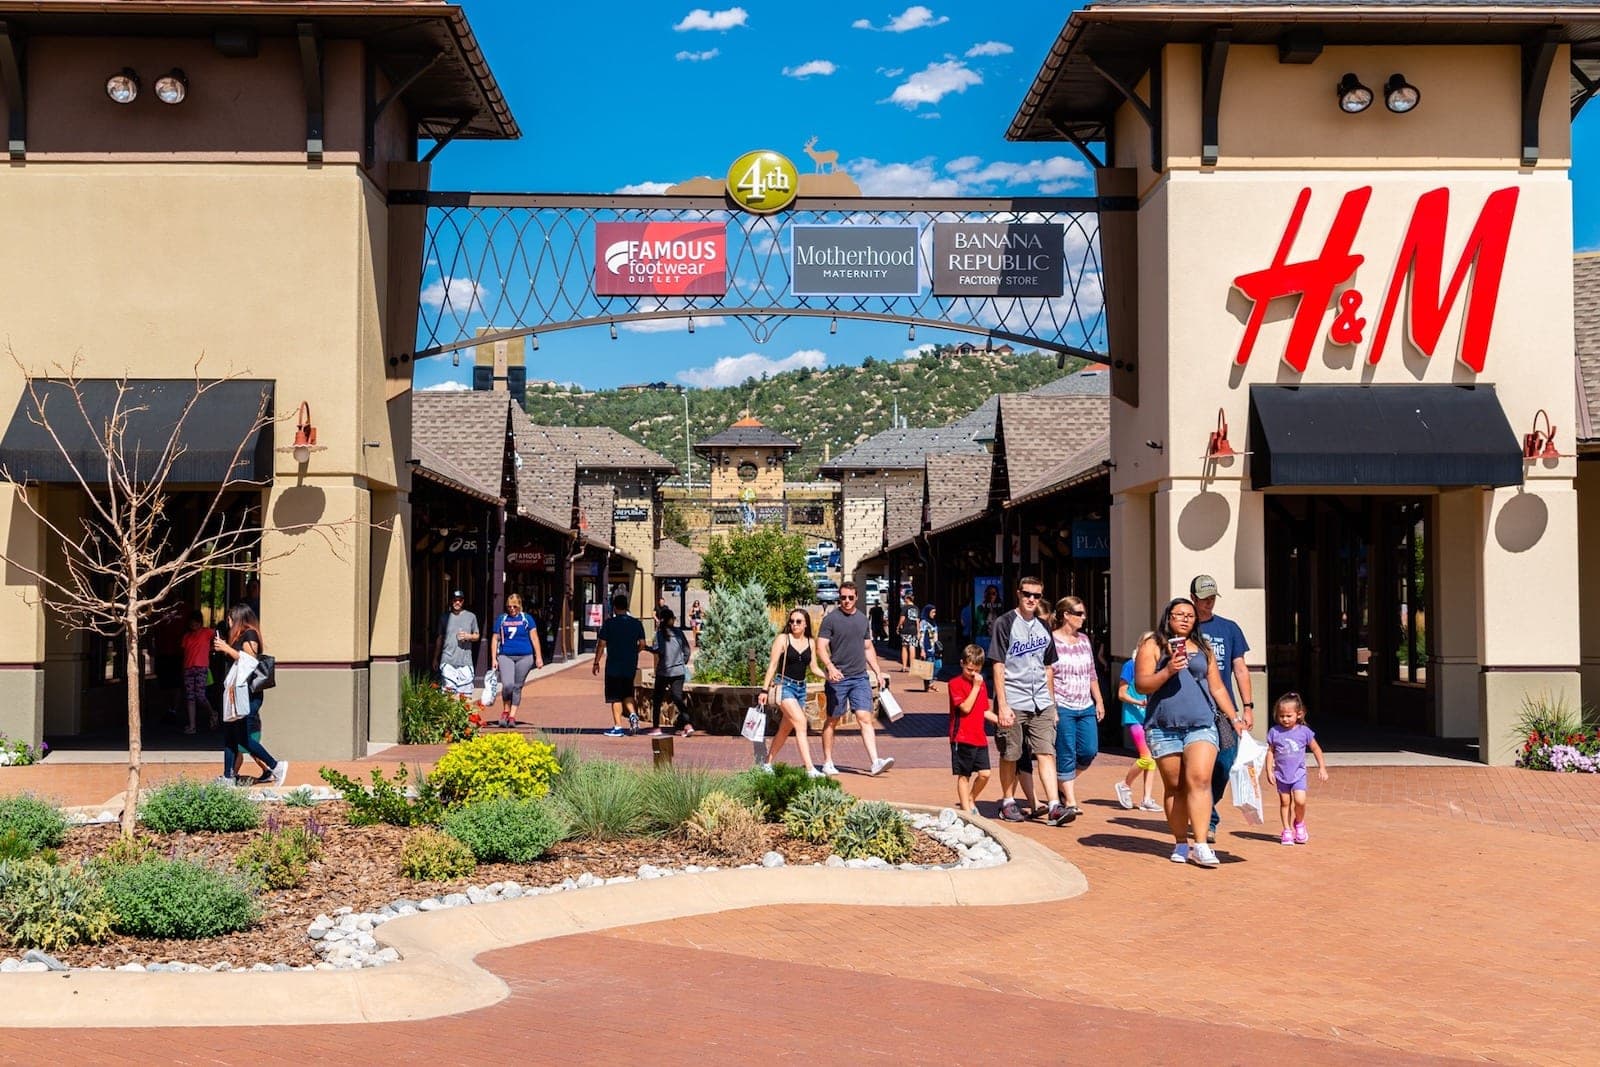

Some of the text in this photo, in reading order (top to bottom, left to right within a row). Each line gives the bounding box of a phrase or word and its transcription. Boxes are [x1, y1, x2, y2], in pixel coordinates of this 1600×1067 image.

[737, 157, 790, 199] 4th
[955, 232, 1043, 249] BANANA
[629, 240, 716, 260] FAMOUS
[796, 245, 915, 266] Motherhood
[629, 259, 705, 275] footwear
[949, 254, 1050, 271] REPUBLIC
[629, 275, 681, 283] OUTLET
[823, 269, 888, 278] MATERNITY
[959, 275, 1039, 285] FACTORY STORE
[1232, 185, 1520, 373] H&M
[507, 626, 518, 640] 7
[1010, 635, 1048, 656] Rockies
